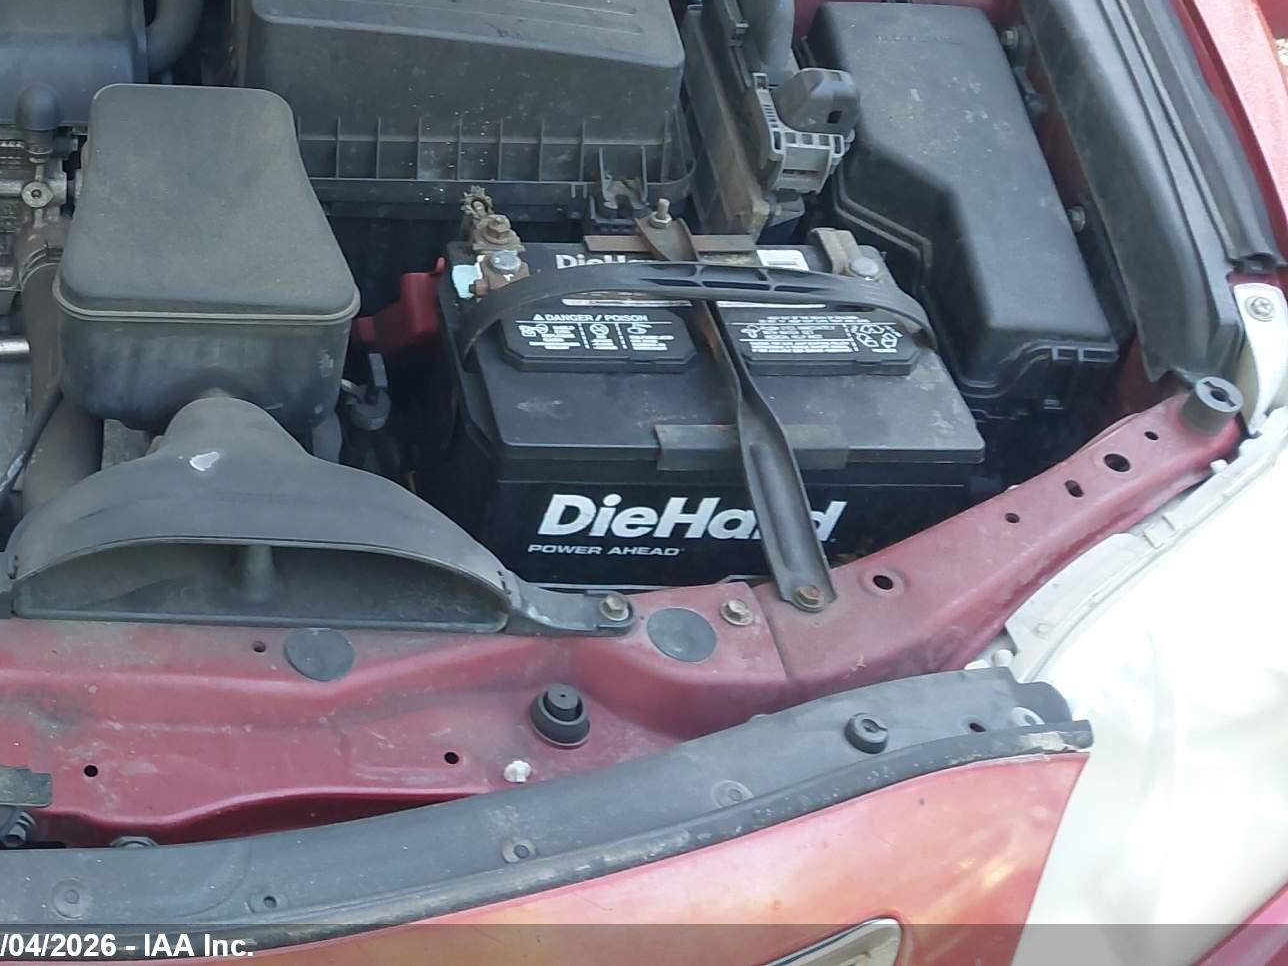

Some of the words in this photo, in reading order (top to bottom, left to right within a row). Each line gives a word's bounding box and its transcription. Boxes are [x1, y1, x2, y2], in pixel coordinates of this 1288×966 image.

[544, 314, 594, 322] DANGER
[604, 314, 649, 322] POISON
[537, 493, 848, 542] DieHad
[527, 544, 602, 556] POWER
[606, 546, 681, 557] AHEAD
